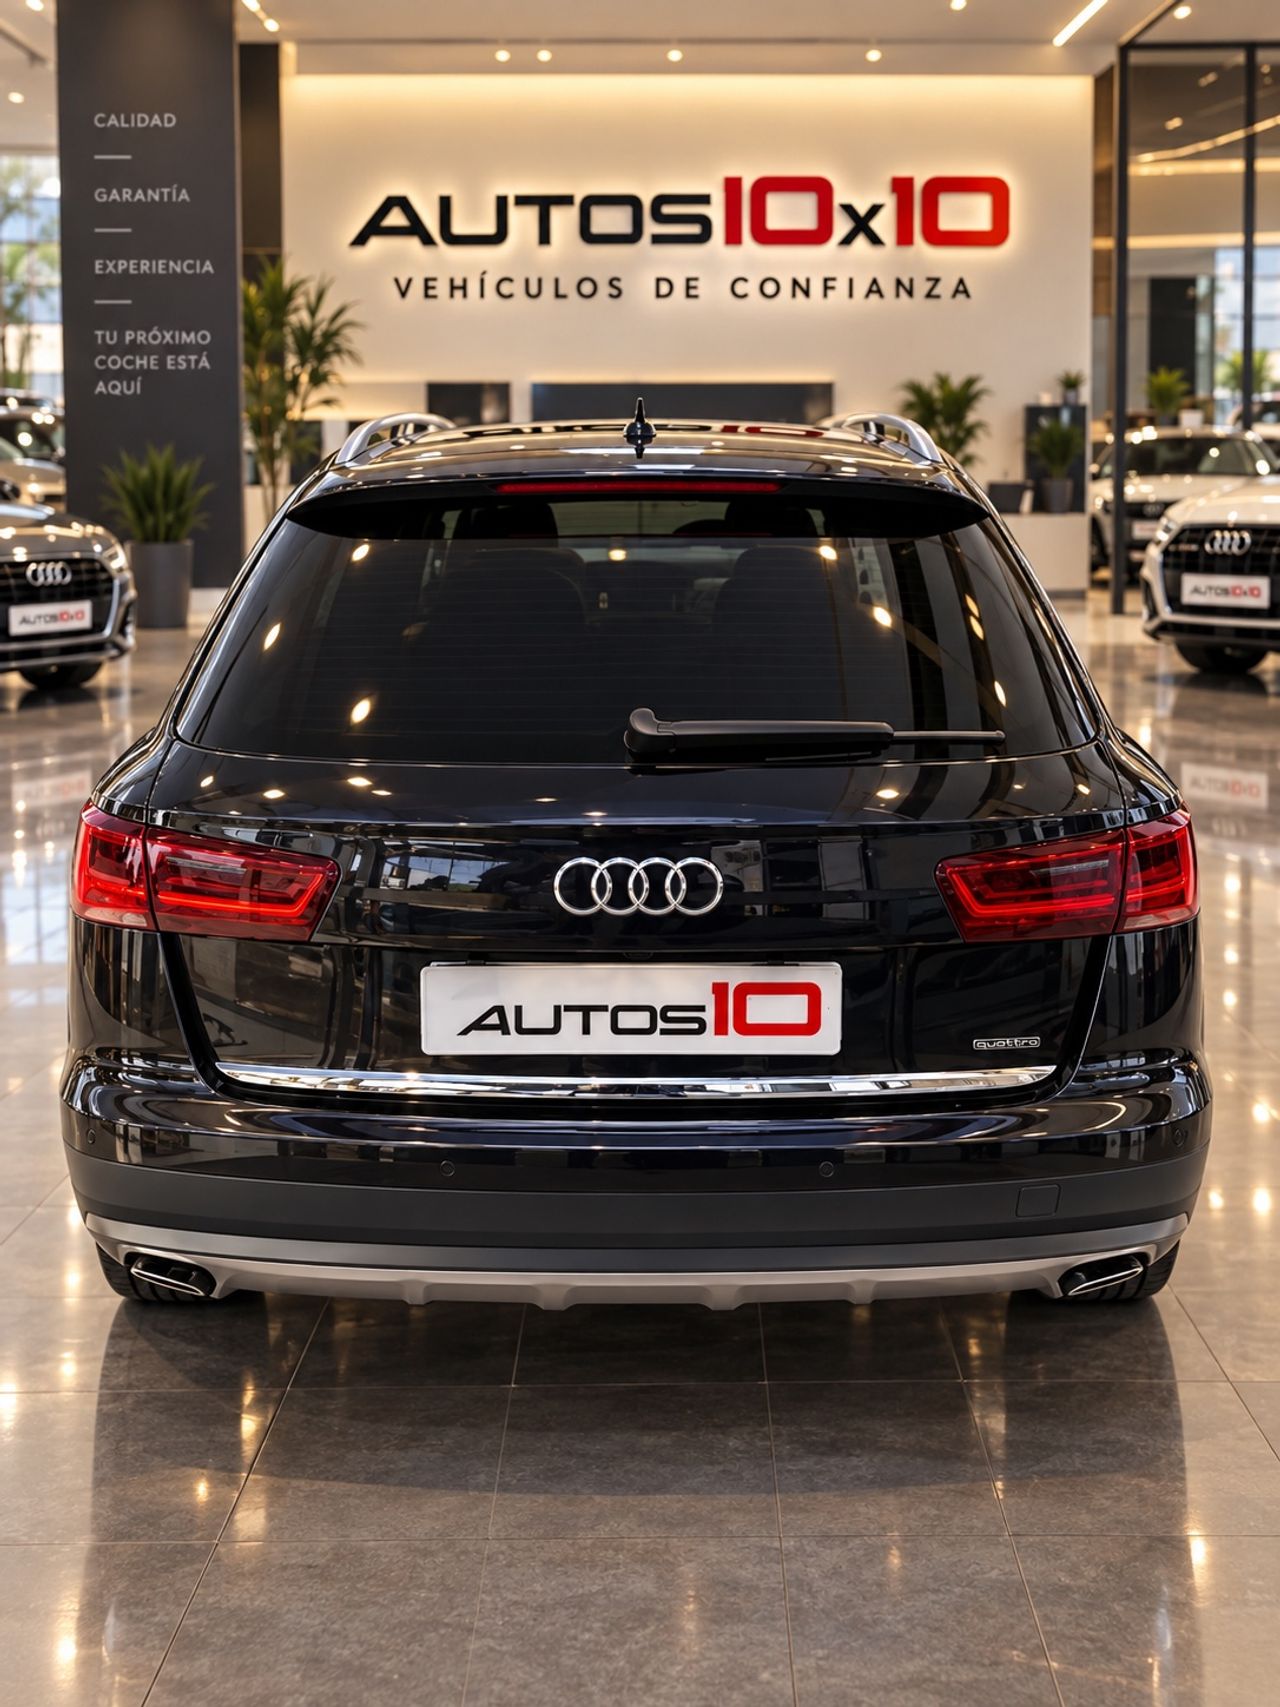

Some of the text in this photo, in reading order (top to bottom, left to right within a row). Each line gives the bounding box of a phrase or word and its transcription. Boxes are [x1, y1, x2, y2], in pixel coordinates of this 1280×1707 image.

[94, 112, 177, 128] CALIDAD
[94, 184, 190, 202] GARANTÍA
[349, 176, 1010, 247] AUTOS10x10
[94, 259, 215, 274] EXPERIENCIA
[393, 270, 972, 300] VEHÍCULOS DE CONFIANZA
[94, 326, 212, 345] TU PRÓXIMO
[94, 351, 211, 370] COCHE ESTÁ
[94, 376, 142, 396] AQUÍ
[457, 981, 822, 1036] AUTOS10
[975, 1038, 1039, 1050] quattro
